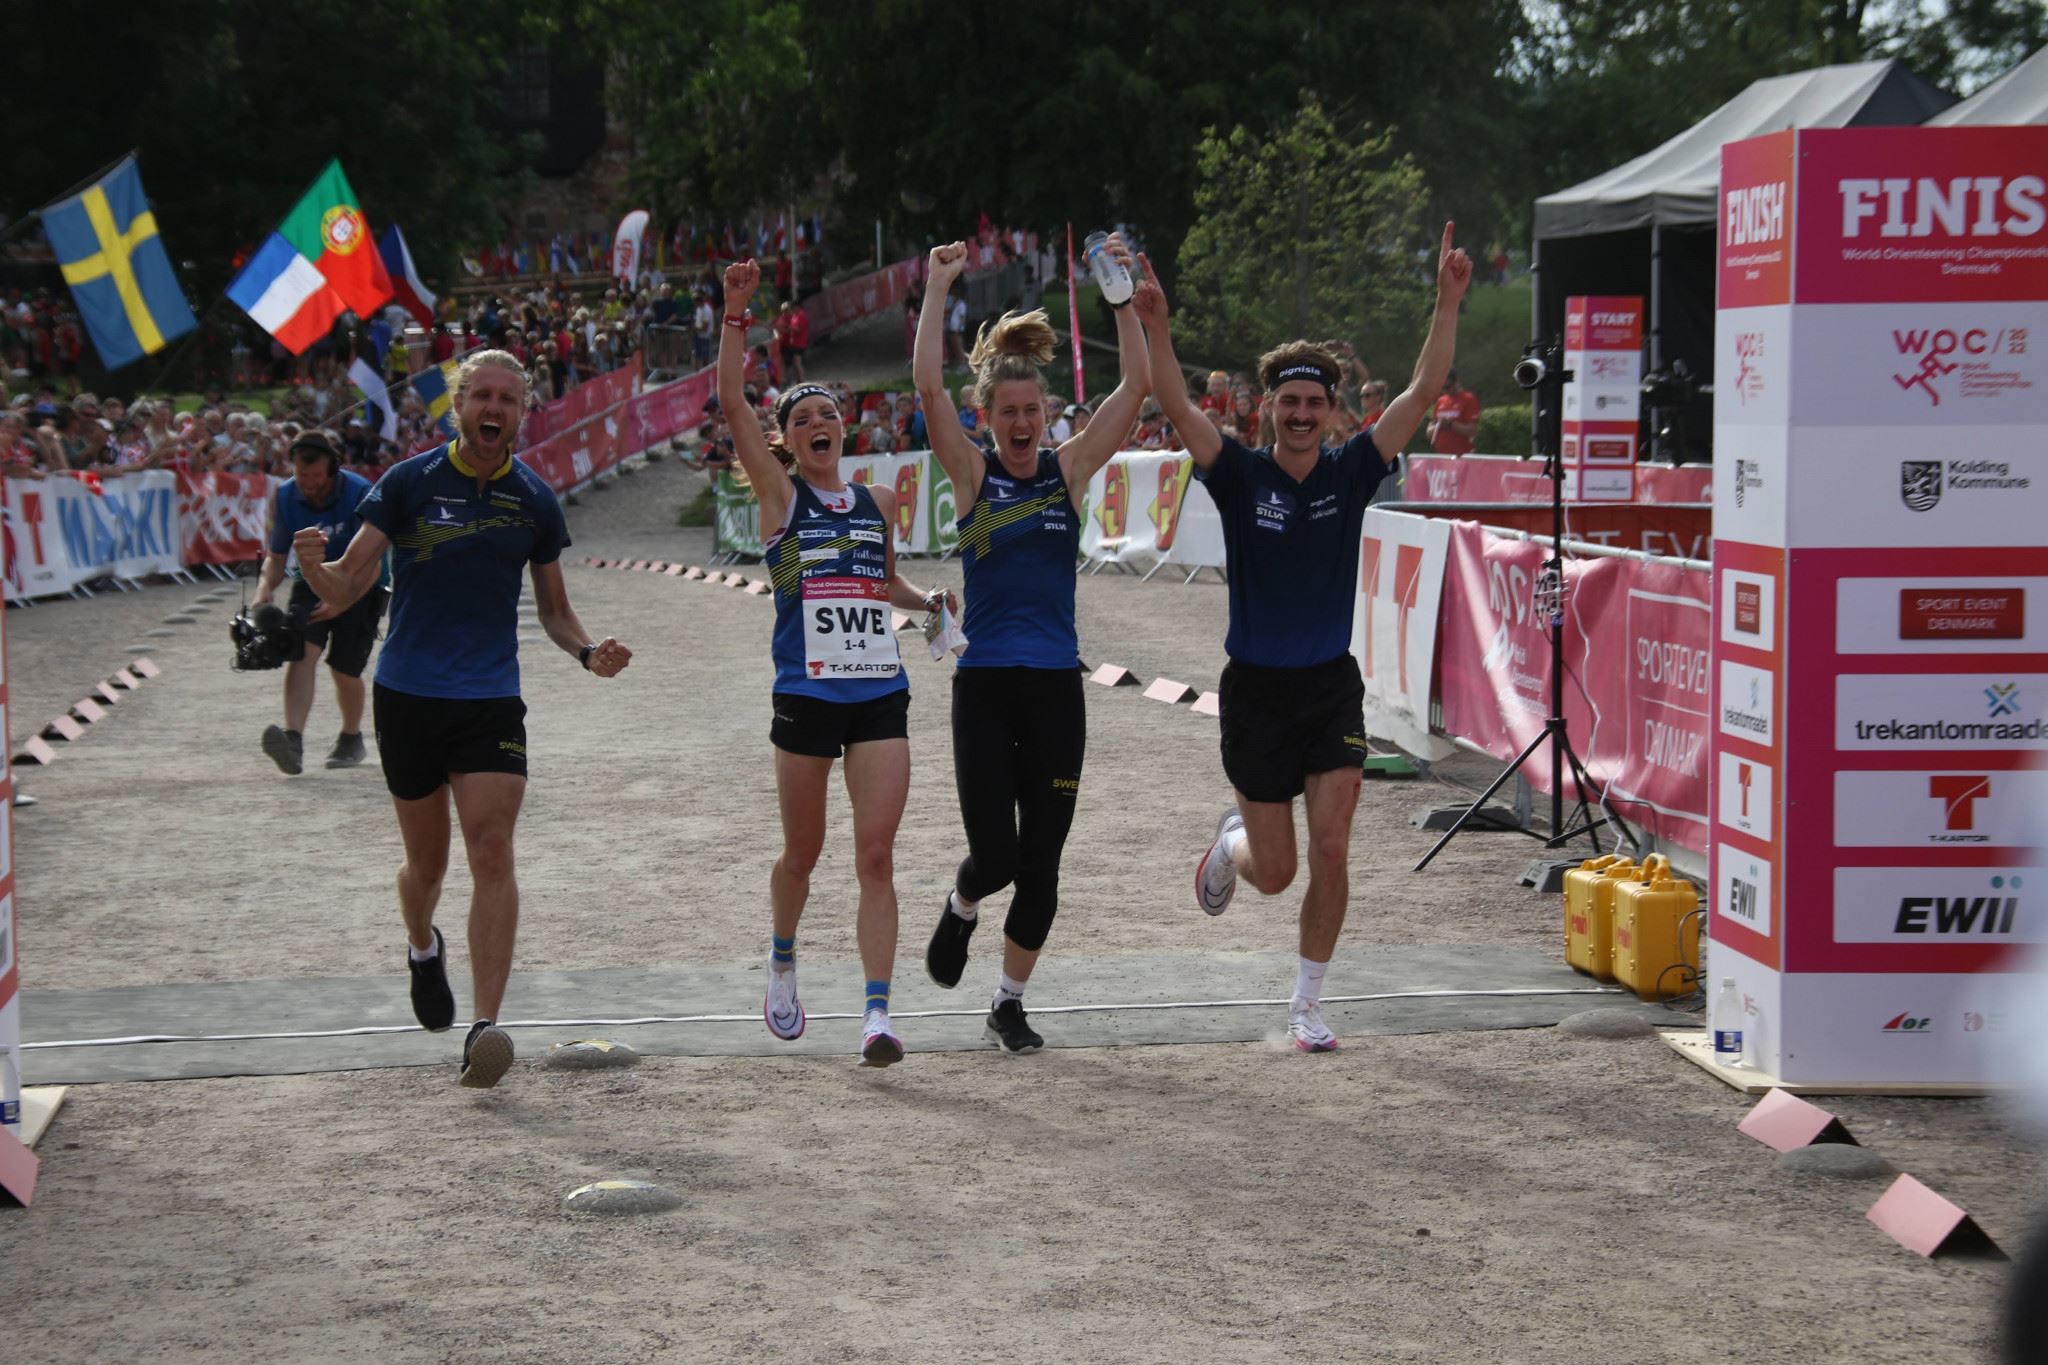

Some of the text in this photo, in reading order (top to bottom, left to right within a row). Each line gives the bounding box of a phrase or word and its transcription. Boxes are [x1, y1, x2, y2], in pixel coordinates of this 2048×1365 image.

[1838, 175, 2048, 238] FINIS
[1726, 181, 1786, 247] FINISH
[1842, 248, 1880, 260] World
[1882, 247, 1964, 261] Orienteering
[1942, 262, 2001, 274] Denmark
[1590, 312, 1637, 326] START
[1948, 460, 2009, 476] Kolding
[1948, 476, 2030, 489] Kommune
[1256, 507, 1284, 520] SILVA
[1044, 523, 1067, 531] SILVA
[852, 565, 885, 578] SILVA
[1916, 597, 2008, 611] SPORT EVENT
[815, 607, 885, 635] SWE
[1927, 618, 1997, 630] DENMARK
[844, 639, 866, 651] 1-4
[829, 664, 898, 672] T-KARTOR
[1928, 834, 1990, 842] T-KARTOR
